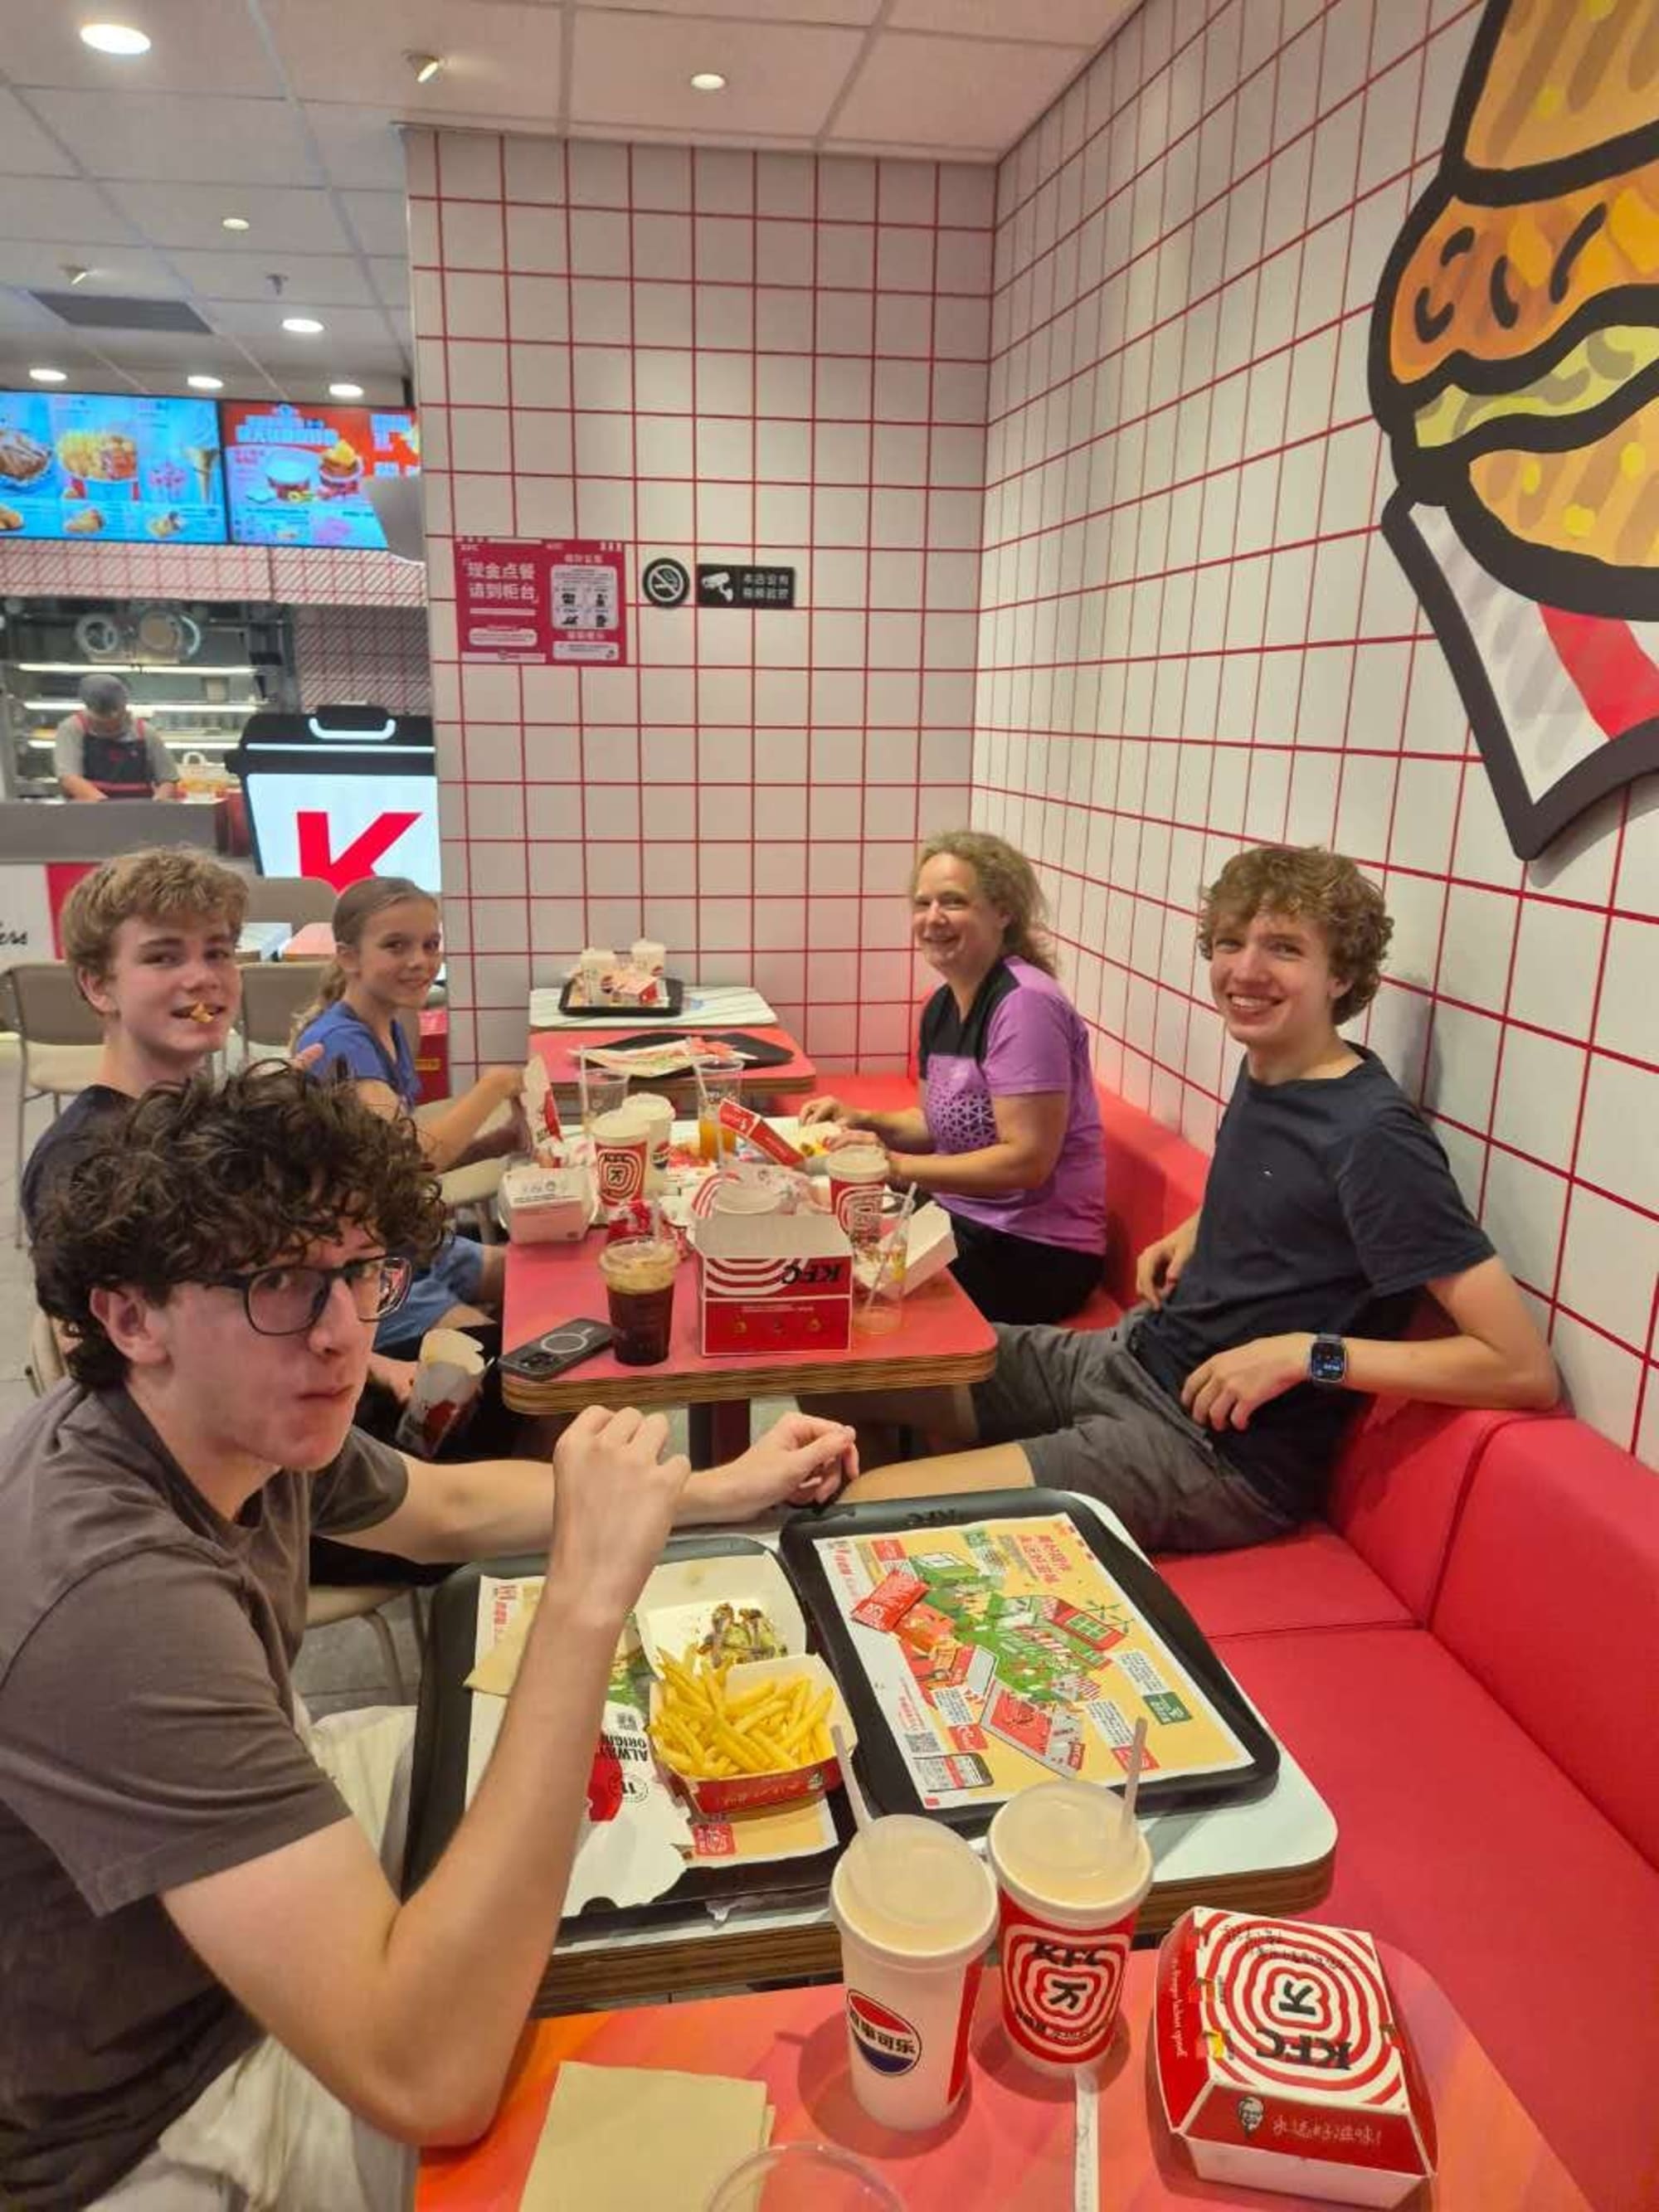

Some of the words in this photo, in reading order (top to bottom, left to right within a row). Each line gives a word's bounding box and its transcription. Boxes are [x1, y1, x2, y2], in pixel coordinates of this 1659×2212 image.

[781, 1264, 842, 1286] KFC
[1034, 1941, 1103, 1966] KFC
[1049, 1979, 1088, 2010] K
[1277, 1979, 1318, 2017] K
[1255, 2027, 1353, 2071] KFC
